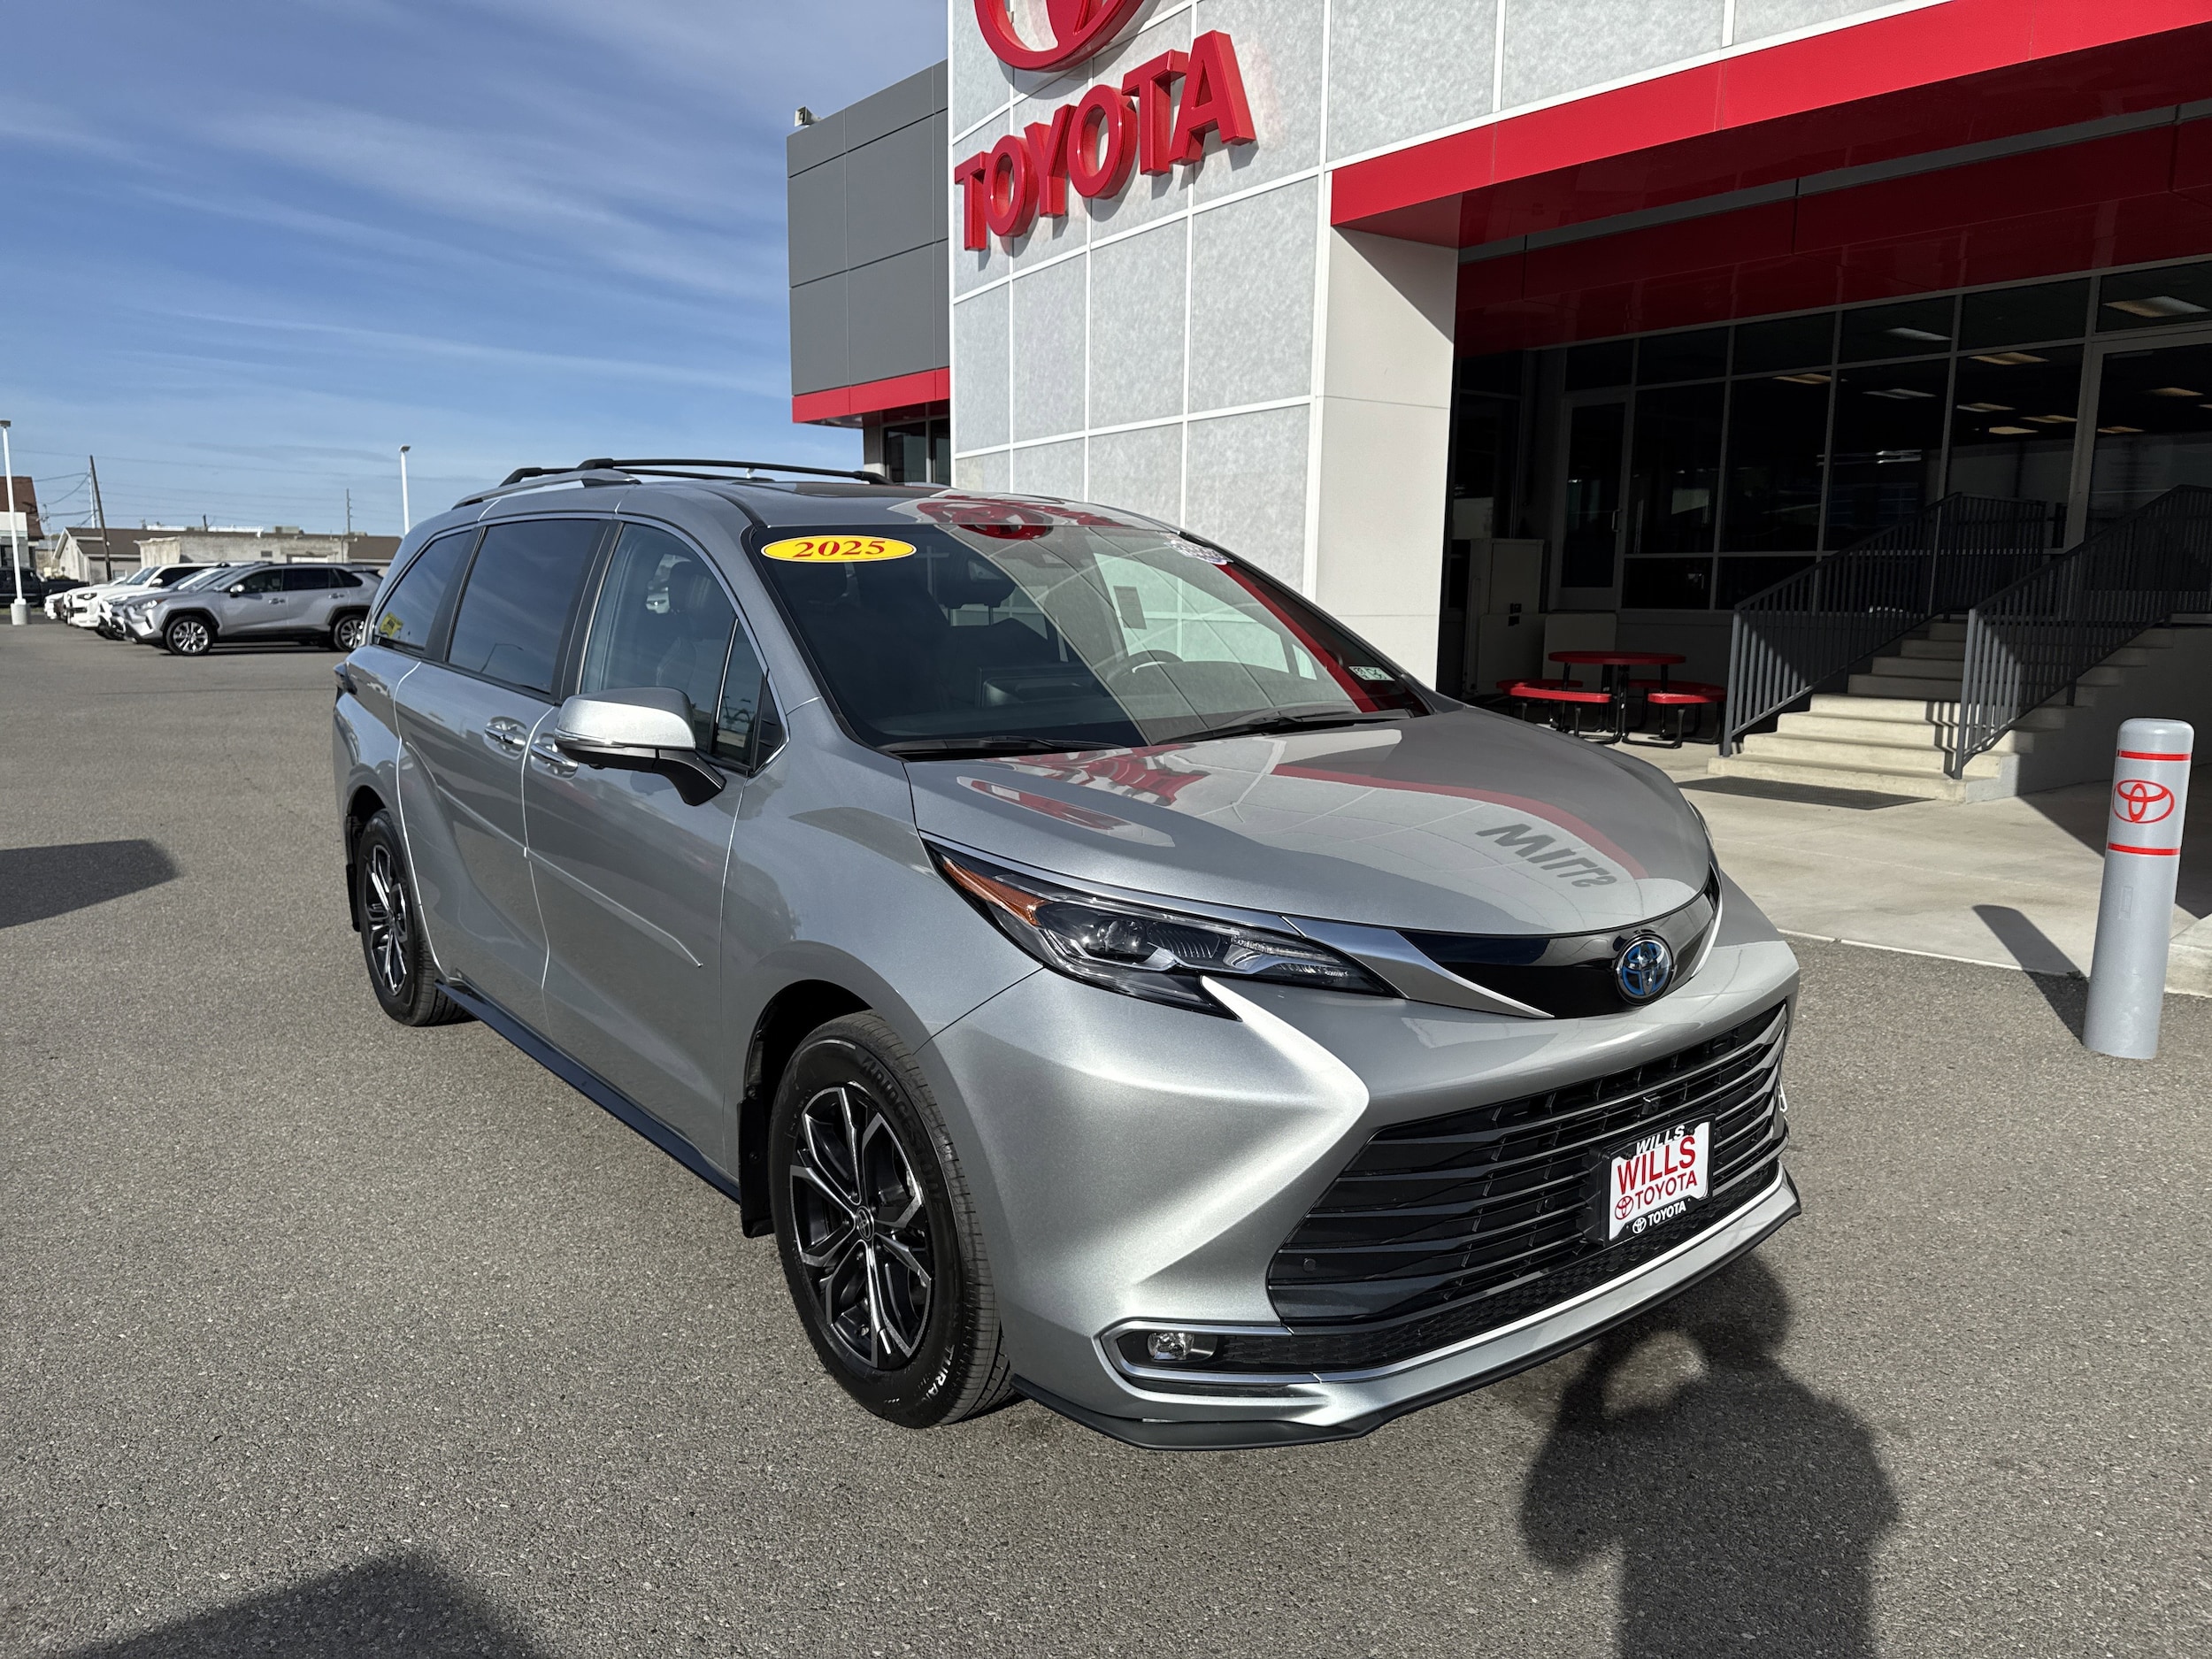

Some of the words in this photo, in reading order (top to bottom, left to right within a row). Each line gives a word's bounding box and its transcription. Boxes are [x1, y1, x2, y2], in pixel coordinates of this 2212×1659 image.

[954, 29, 1256, 251] TOYOTA
[793, 541, 886, 558] 2025
[1637, 1125, 1686, 1154] WILLS
[1617, 1136, 1696, 1194] WILLS
[1635, 1170, 1698, 1209] TOYOTA
[1647, 1201, 1686, 1226] TOYOTA
